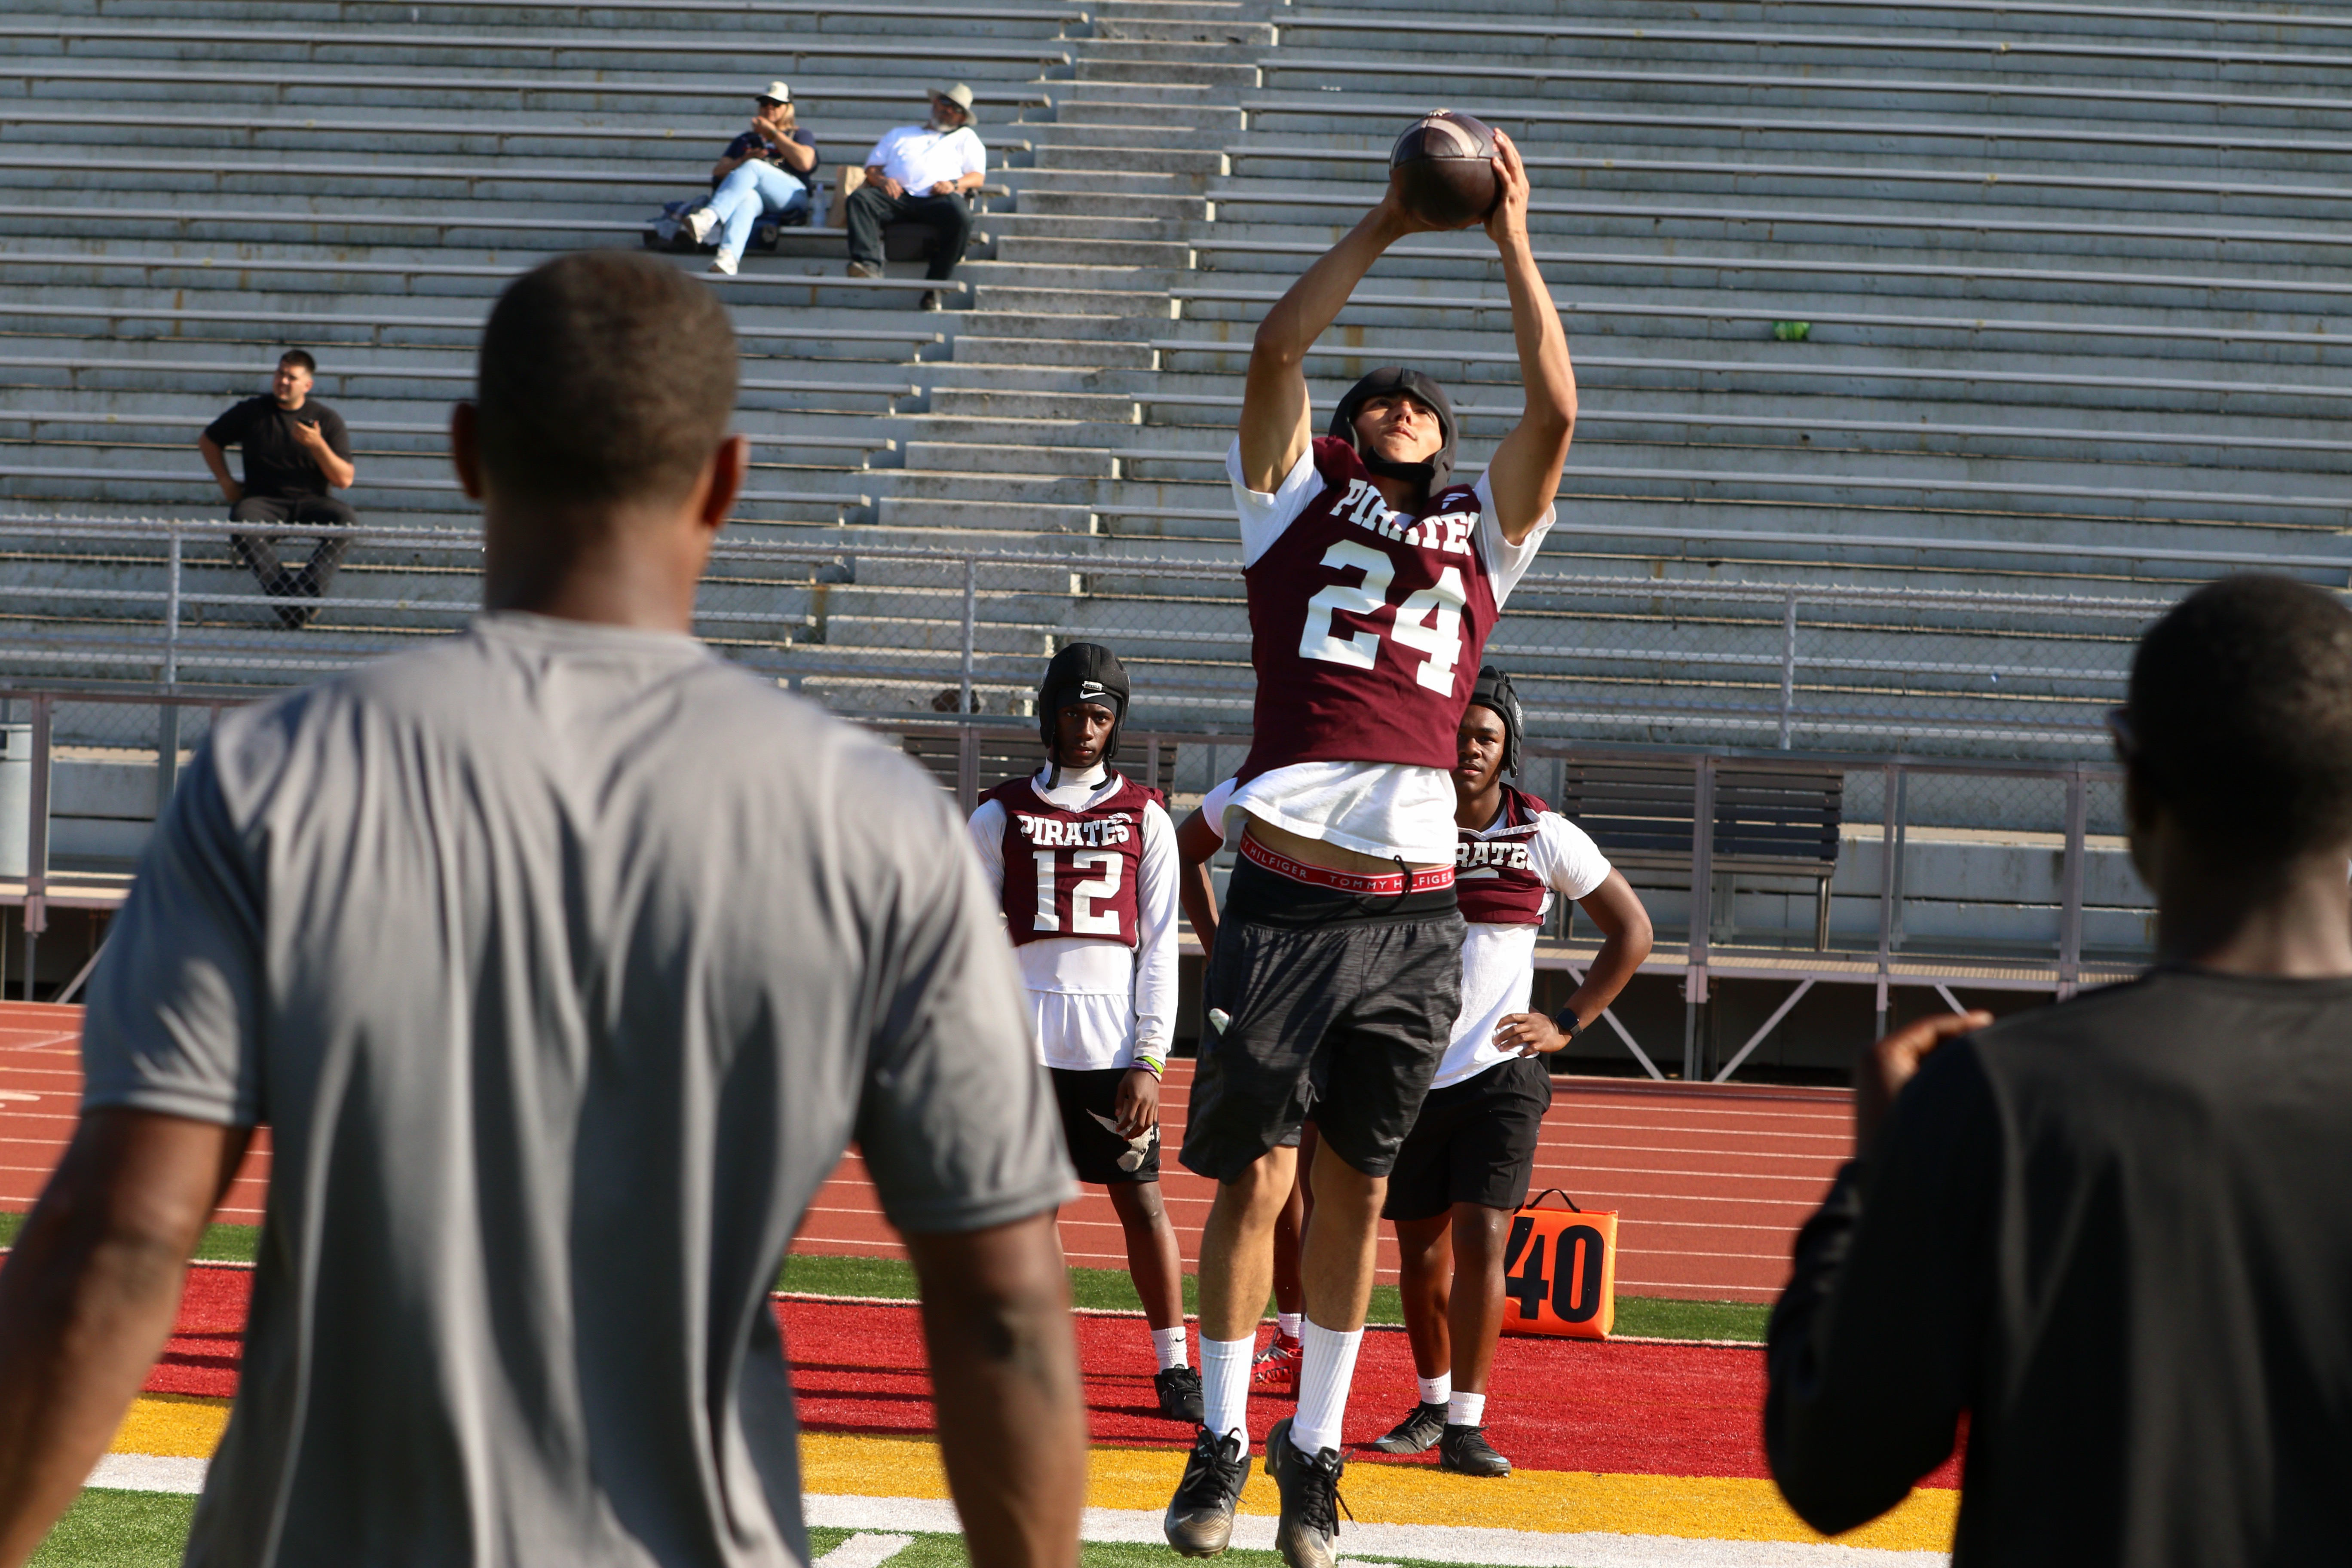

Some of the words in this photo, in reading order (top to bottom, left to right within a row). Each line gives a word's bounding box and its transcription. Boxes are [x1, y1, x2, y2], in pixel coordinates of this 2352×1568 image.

[1298, 539, 1466, 698] 24
[1017, 812, 1132, 847] PIRATES
[1455, 842, 1533, 870] RATE
[1033, 850, 1124, 935] 12
[1250, 846, 1306, 878] HILFIGER
[1329, 875, 1387, 889] TOMMY
[1393, 871, 1452, 888] HFIGER
[1504, 1216, 1604, 1323] 40
